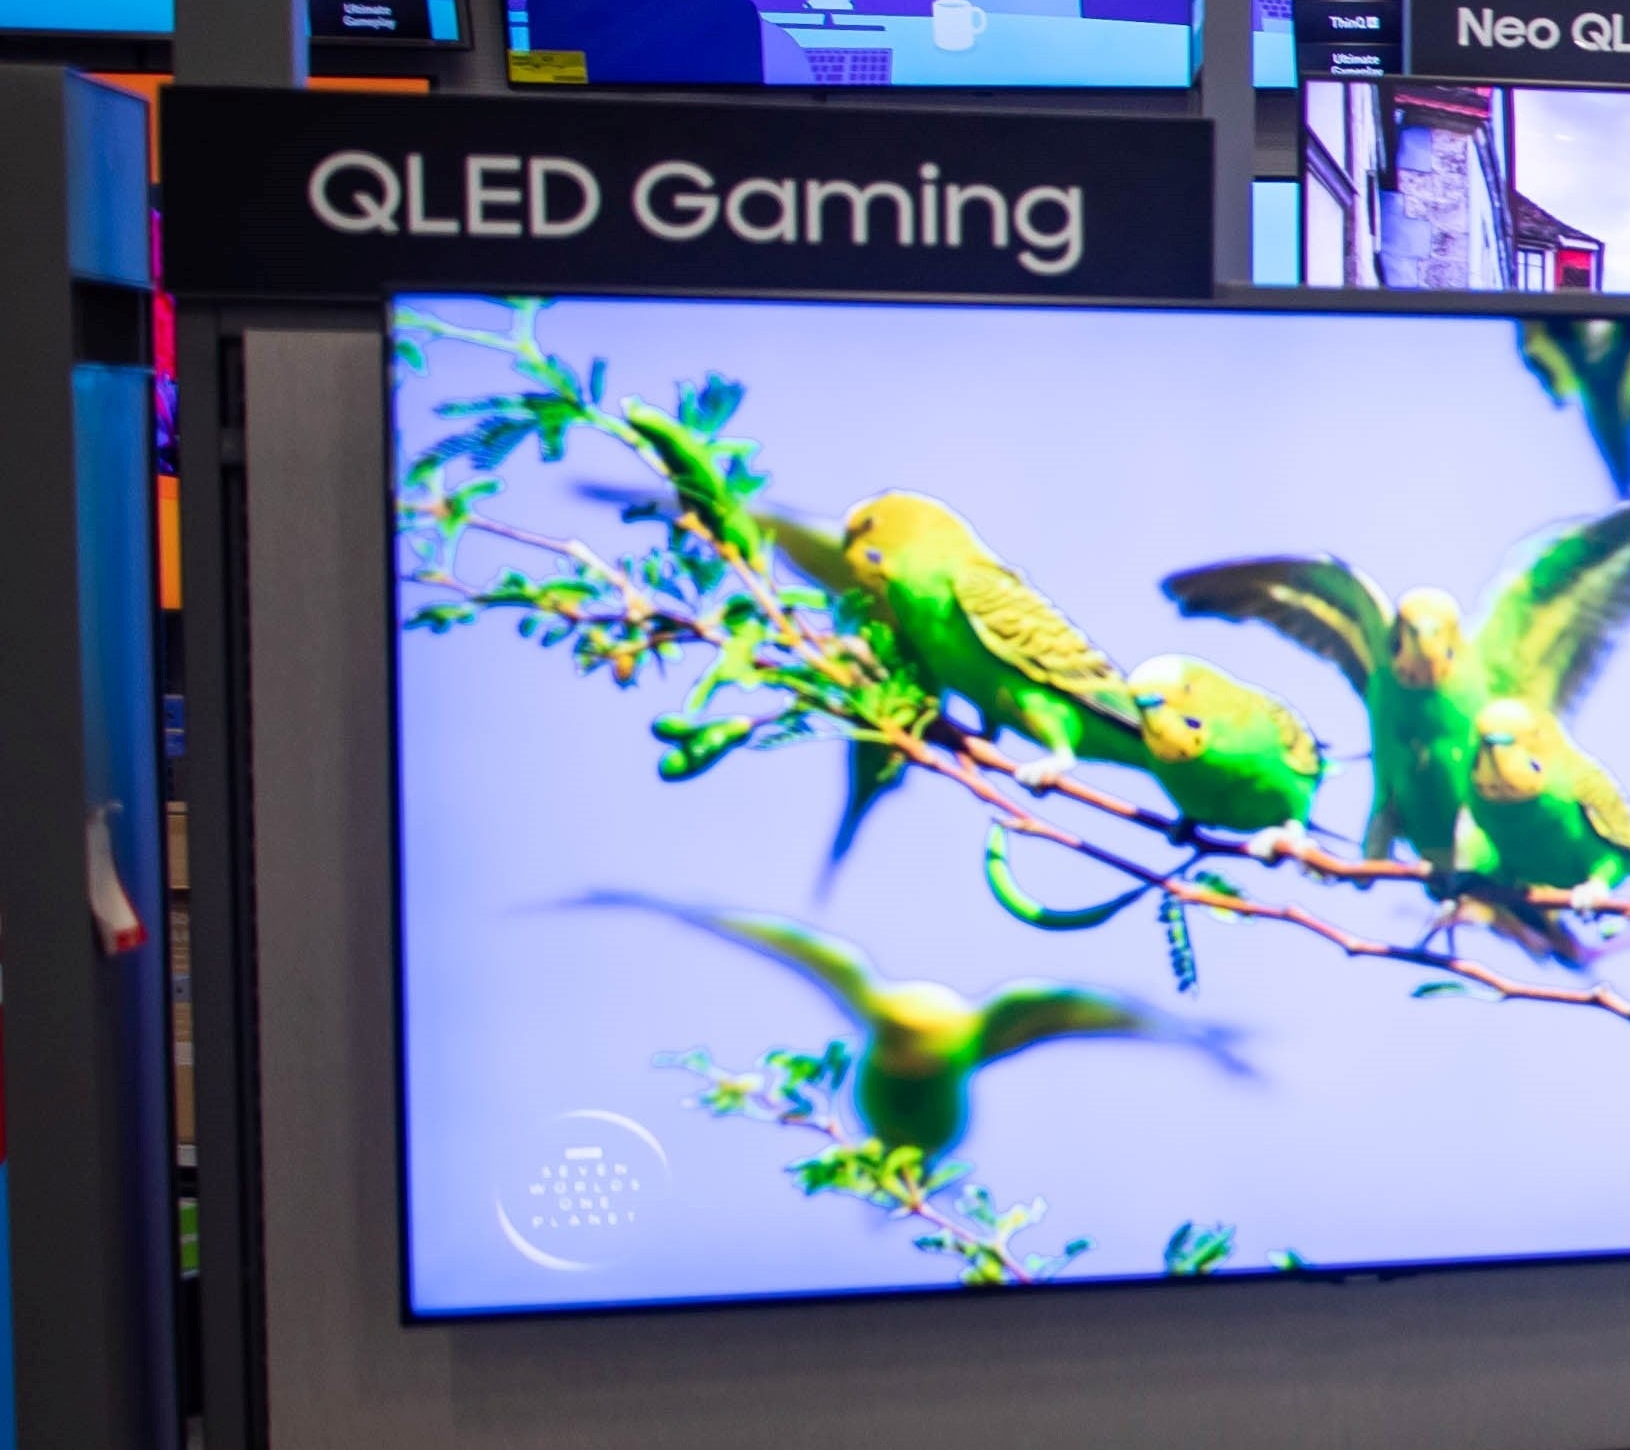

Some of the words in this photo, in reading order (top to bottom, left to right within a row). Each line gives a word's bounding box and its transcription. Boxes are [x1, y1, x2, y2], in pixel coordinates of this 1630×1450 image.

[1456, 6, 1559, 50] Neo
[307, 151, 600, 237] QLED
[631, 161, 1083, 275] Gaming
